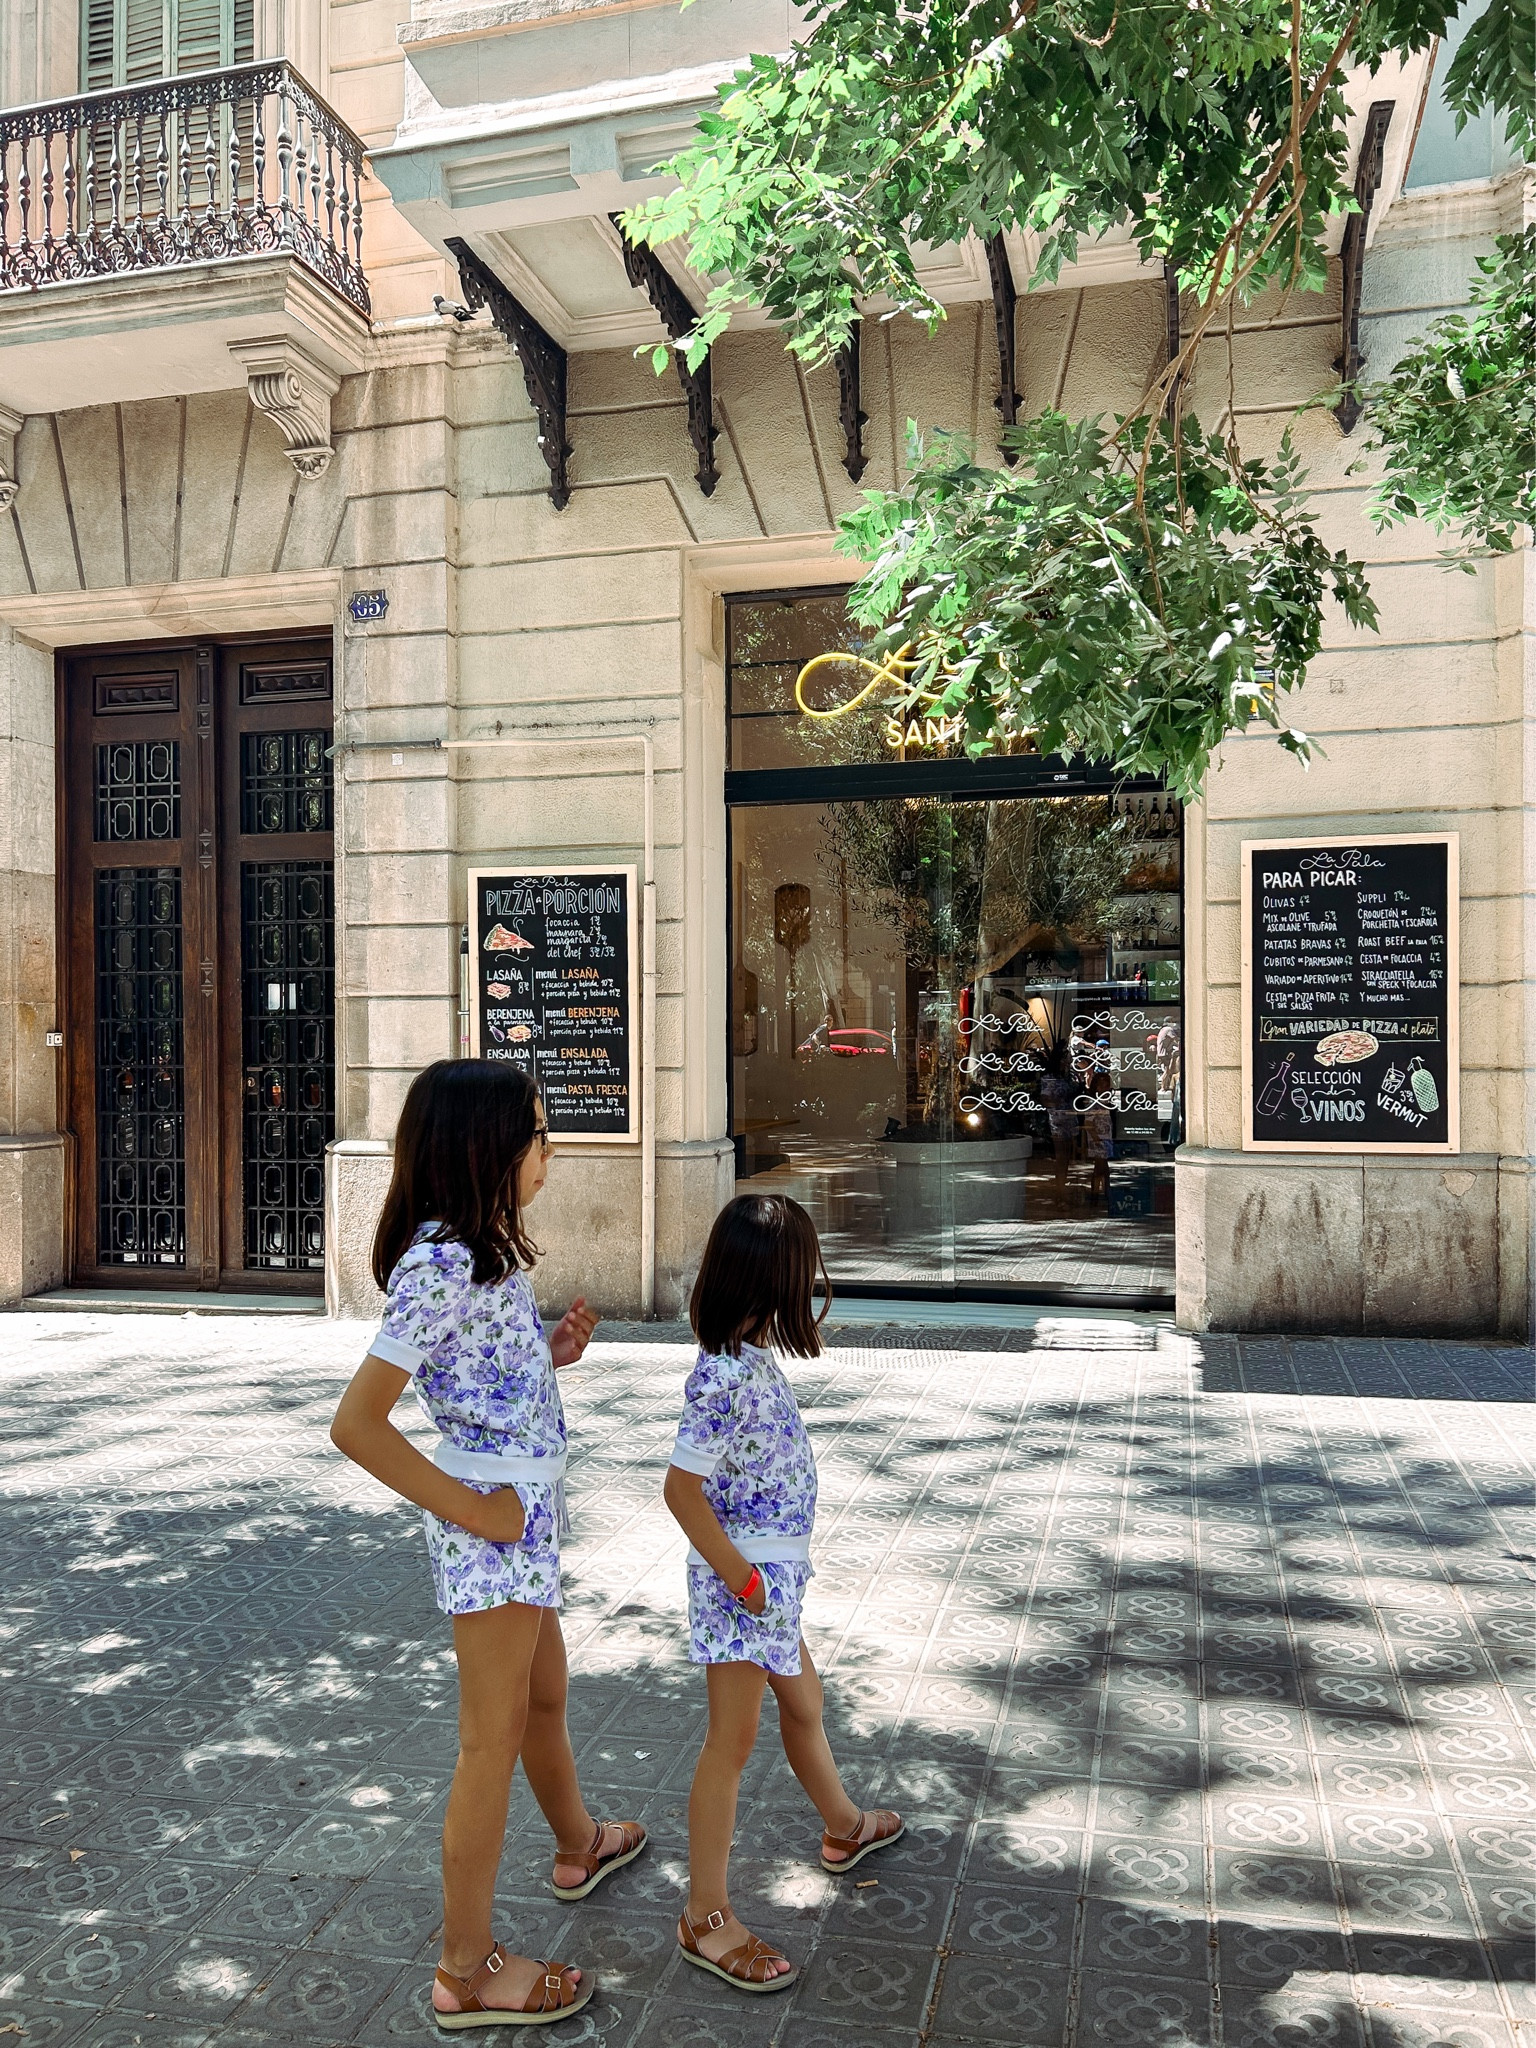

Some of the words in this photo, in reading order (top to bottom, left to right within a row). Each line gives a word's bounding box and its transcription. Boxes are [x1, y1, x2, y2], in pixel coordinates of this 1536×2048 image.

[1300, 852, 1336, 870] La
[1335, 848, 1386, 869] Pala
[514, 877, 538, 888] La
[538, 876, 580, 888] Pala
[1263, 871, 1304, 889] PARA
[1311, 870, 1362, 887] PICAR:
[486, 889, 536, 915] PIZZA
[543, 882, 620, 914] PORCIÓN
[1263, 896, 1295, 909] OLIVAS
[1357, 892, 1386, 904] SUPPLI
[1263, 913, 1278, 924] MIX
[1289, 912, 1310, 922] OLIVE
[1358, 907, 1398, 919] CROQUETÓN
[545, 916, 580, 928] focaccia
[1267, 923, 1301, 933] ASCOLANE
[1308, 922, 1337, 931] TRUFADA
[1362, 919, 1399, 929] PORCHETTA
[1405, 918, 1437, 927] ESCAROLA
[547, 934, 591, 951] margarita
[1264, 939, 1297, 950] PATATAS
[1301, 939, 1331, 950] BRAVAS
[1358, 936, 1381, 947] ROAST
[1385, 936, 1406, 946] BEEF
[547, 946, 561, 958] del
[564, 945, 581, 960] chef
[1360, 953, 1382, 964] CESTA
[1390, 953, 1422, 964] FOCACCIA
[1264, 955, 1295, 967] CUBITOS
[1304, 955, 1343, 967] PARMESANO
[487, 968, 523, 981] LASAÑA
[536, 968, 557, 979] menú
[561, 967, 599, 979] LASAÑA
[1361, 970, 1415, 981] STRACCIATELLA
[579, 979, 599, 988] bebida
[1265, 974, 1296, 985] VARIADO
[1303, 974, 1339, 984] APERITIVO
[1378, 981, 1399, 989] SPECK
[1407, 980, 1437, 989] FOCACCIA
[590, 988, 608, 997] bebida
[1266, 992, 1287, 1003] CESTA
[1295, 992, 1314, 1004] PIZZA
[1316, 991, 1336, 1002] FRITA
[1360, 992, 1366, 1002] Y
[1291, 1002, 1313, 1010] SALSAS
[487, 1008, 535, 1020] BERENJENA
[545, 1007, 566, 1017] menú
[568, 1007, 620, 1018] BERENJENA
[958, 1014, 1004, 1034] La
[1001, 1013, 1044, 1034] Pala
[1072, 1011, 1118, 1032] La
[1115, 1010, 1162, 1032] Pala
[1264, 1020, 1288, 1039] Gran
[1289, 1020, 1349, 1036] VARIEDAD
[1352, 1021, 1360, 1029] DE
[1362, 1020, 1398, 1034] PIZZA
[1400, 1022, 1408, 1033] al
[1411, 1022, 1437, 1037] plato
[487, 1049, 530, 1059] ENSALADA
[537, 1048, 557, 1058] menú
[561, 1048, 608, 1059] ENSALADA
[959, 1052, 1005, 1073] La
[1002, 1052, 1045, 1073] Pala
[1291, 1069, 1361, 1085] SELECCIÓN
[547, 1084, 567, 1094] menú
[568, 1085, 593, 1095] PASTA
[597, 1085, 627, 1095] FRESCA
[959, 1092, 1006, 1112] La
[1002, 1091, 1046, 1112] Pala
[1073, 1091, 1120, 1112] La
[1117, 1091, 1163, 1112] Pala
[1310, 1100, 1366, 1122] VINOS
[1377, 1092, 1428, 1128] VERMUT
